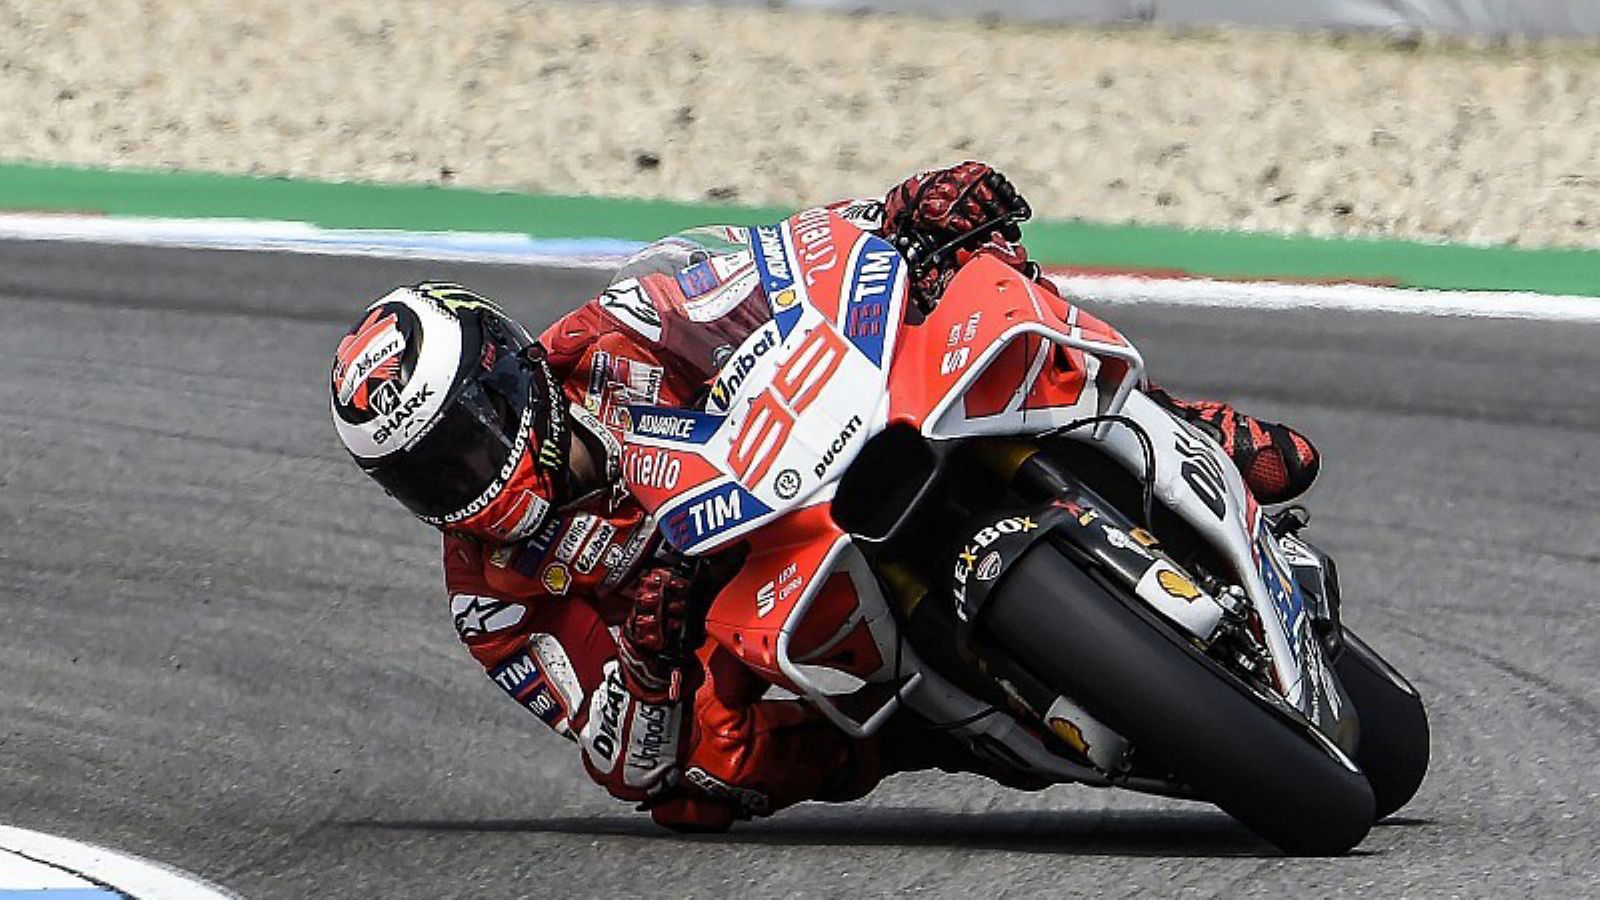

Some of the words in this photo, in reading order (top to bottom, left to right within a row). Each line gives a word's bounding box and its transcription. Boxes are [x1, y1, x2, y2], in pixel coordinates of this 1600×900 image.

[854, 250, 896, 302] TIM
[711, 328, 777, 412] Unibat
[373, 382, 435, 445] SHARK
[637, 414, 696, 438] ADVANCE
[727, 321, 850, 492] 99
[813, 414, 864, 480] DUCATI
[689, 488, 743, 536] TIM
[494, 655, 538, 691] TIM
